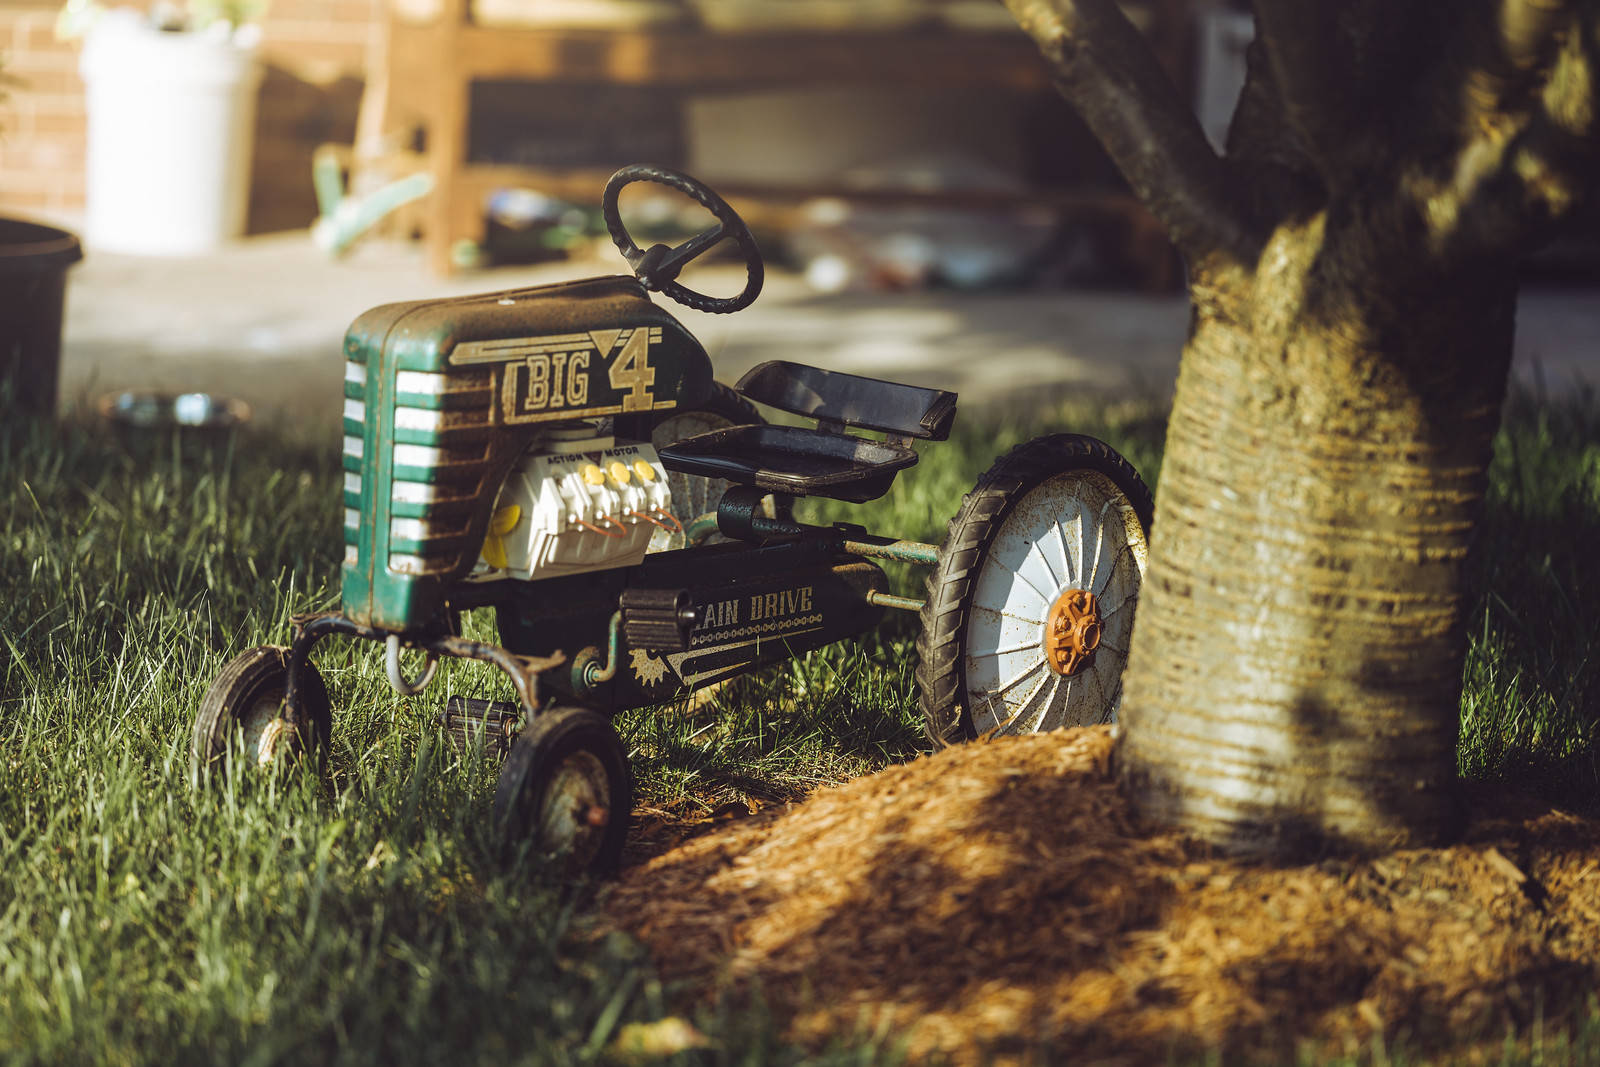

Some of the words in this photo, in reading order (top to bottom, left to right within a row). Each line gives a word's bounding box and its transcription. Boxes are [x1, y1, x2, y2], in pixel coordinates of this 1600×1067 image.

[524, 351, 590, 411] BIG
[608, 326, 656, 413] 4
[547, 453, 584, 465] ACTION
[604, 446, 640, 457] MOTOR
[695, 599, 740, 632] AIN
[750, 586, 813, 621] DRIVE
